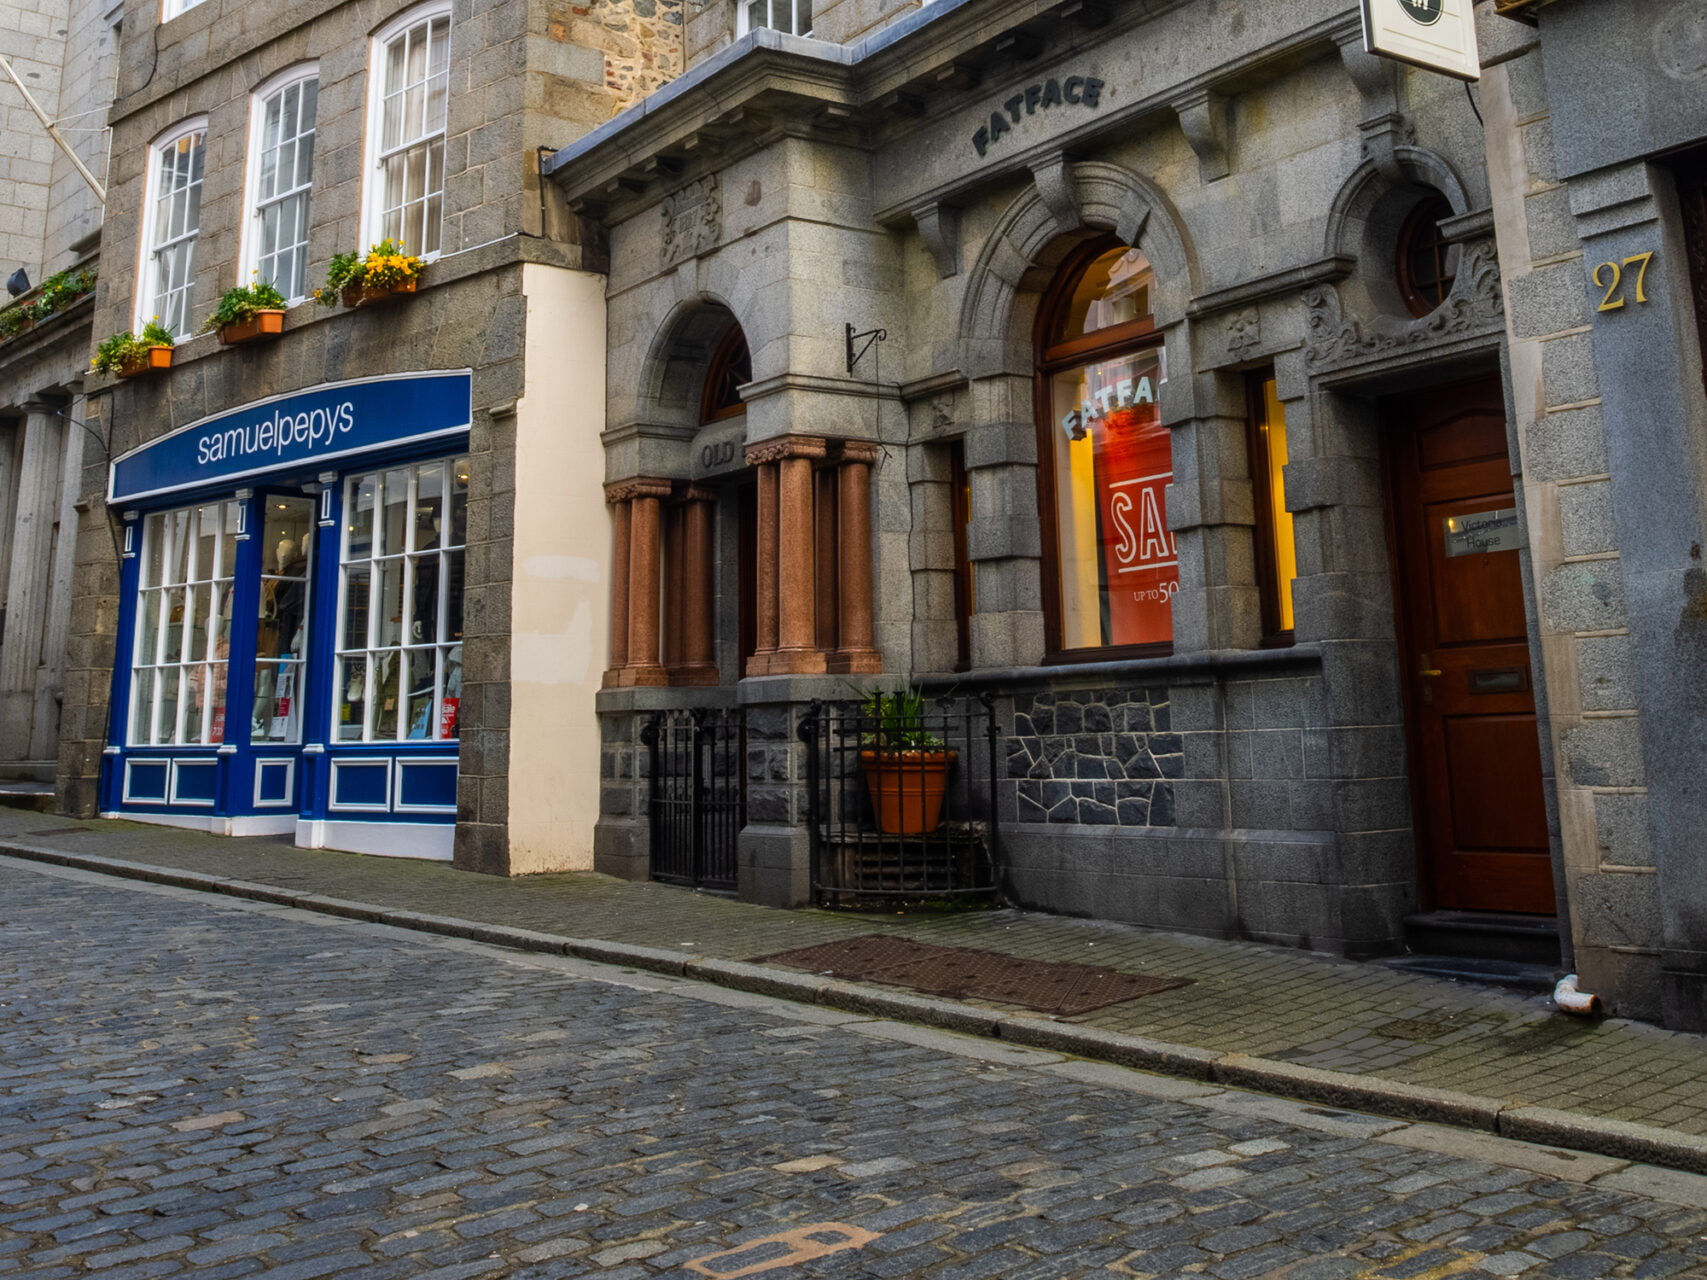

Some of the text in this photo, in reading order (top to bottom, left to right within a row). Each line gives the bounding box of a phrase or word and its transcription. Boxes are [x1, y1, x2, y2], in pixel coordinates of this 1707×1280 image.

[971, 75, 1105, 157] FATFACE
[1592, 251, 1655, 312] 27
[1061, 376, 1168, 440] FATFA
[197, 401, 354, 465] samuelpepys
[701, 440, 735, 468] OLD
[1461, 517, 1503, 532] Victoria
[1466, 535, 1501, 548] House
[1133, 591, 1146, 601] UP
[1146, 589, 1159, 600] TO
